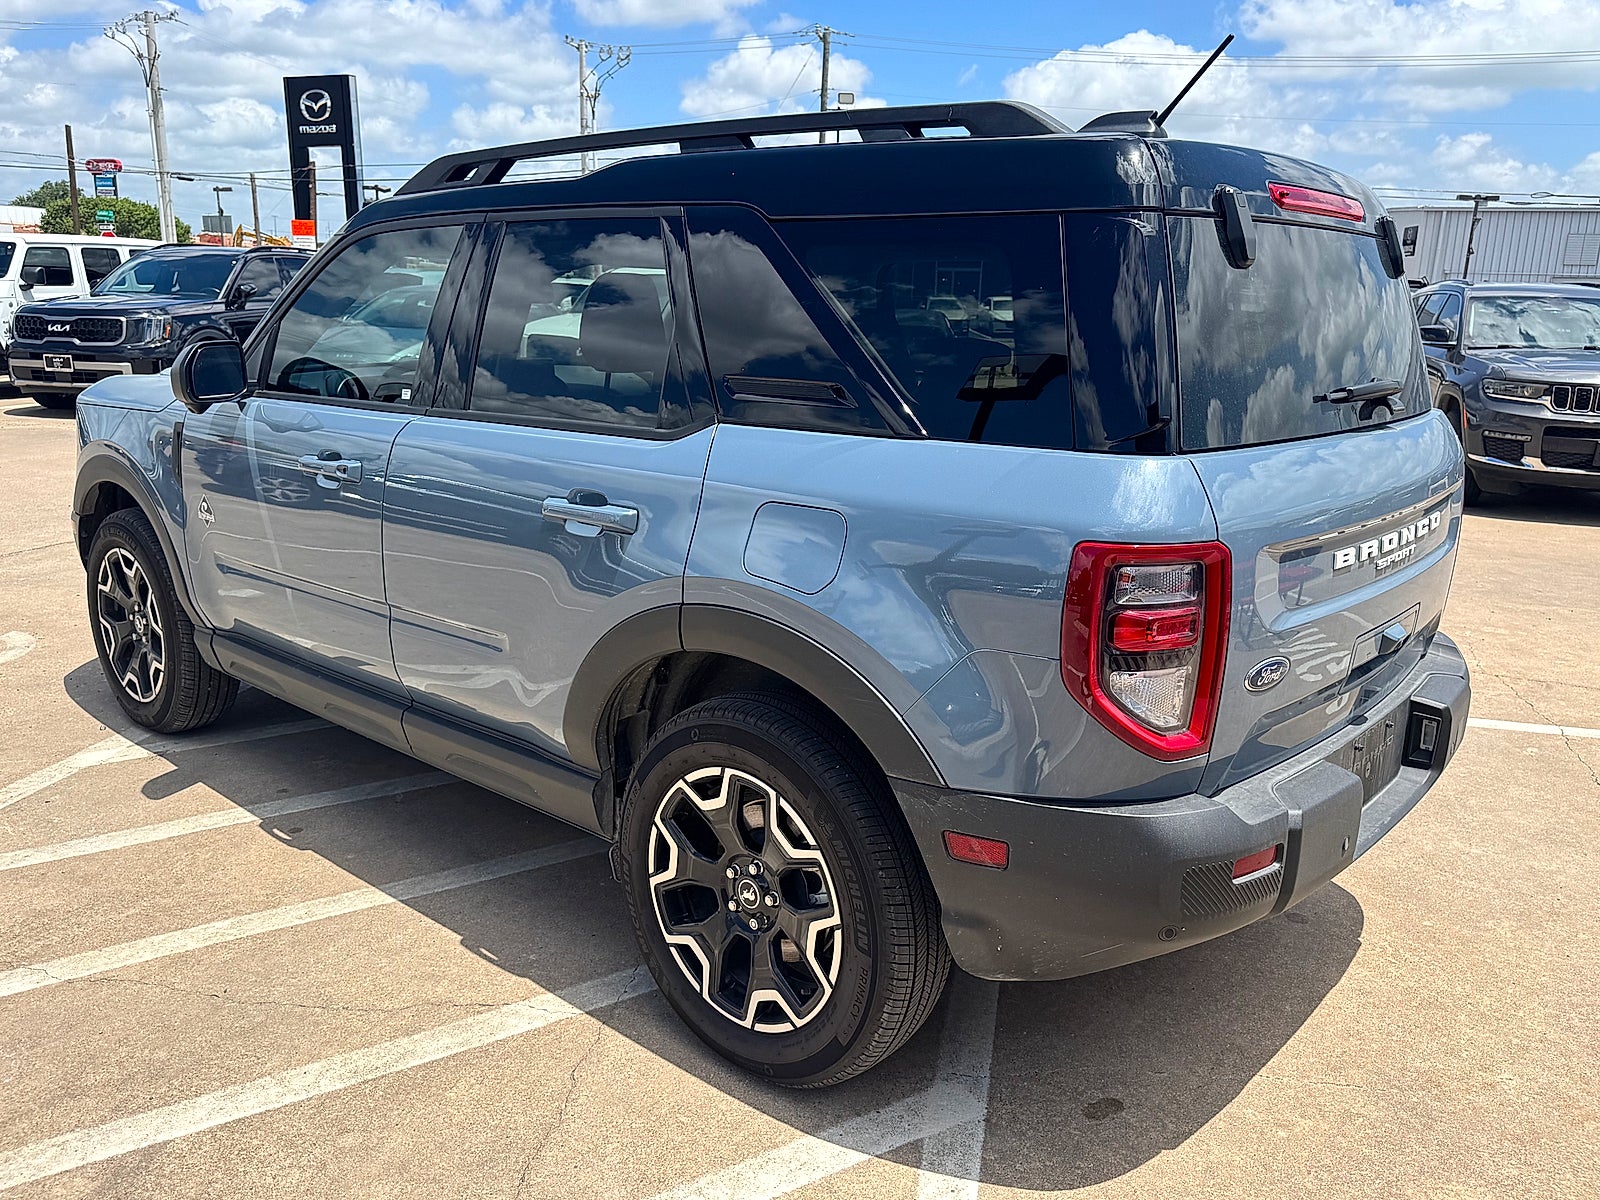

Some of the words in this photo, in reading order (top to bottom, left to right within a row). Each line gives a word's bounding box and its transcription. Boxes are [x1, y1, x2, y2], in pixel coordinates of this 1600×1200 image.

[299, 124, 337, 134] mazda
[1332, 511, 1441, 571] BRONCO
[1375, 543, 1417, 570] SPORT
[1257, 664, 1283, 686] Ford
[830, 838, 870, 952] MICHELIN
[850, 966, 869, 1021] PRIMACY
